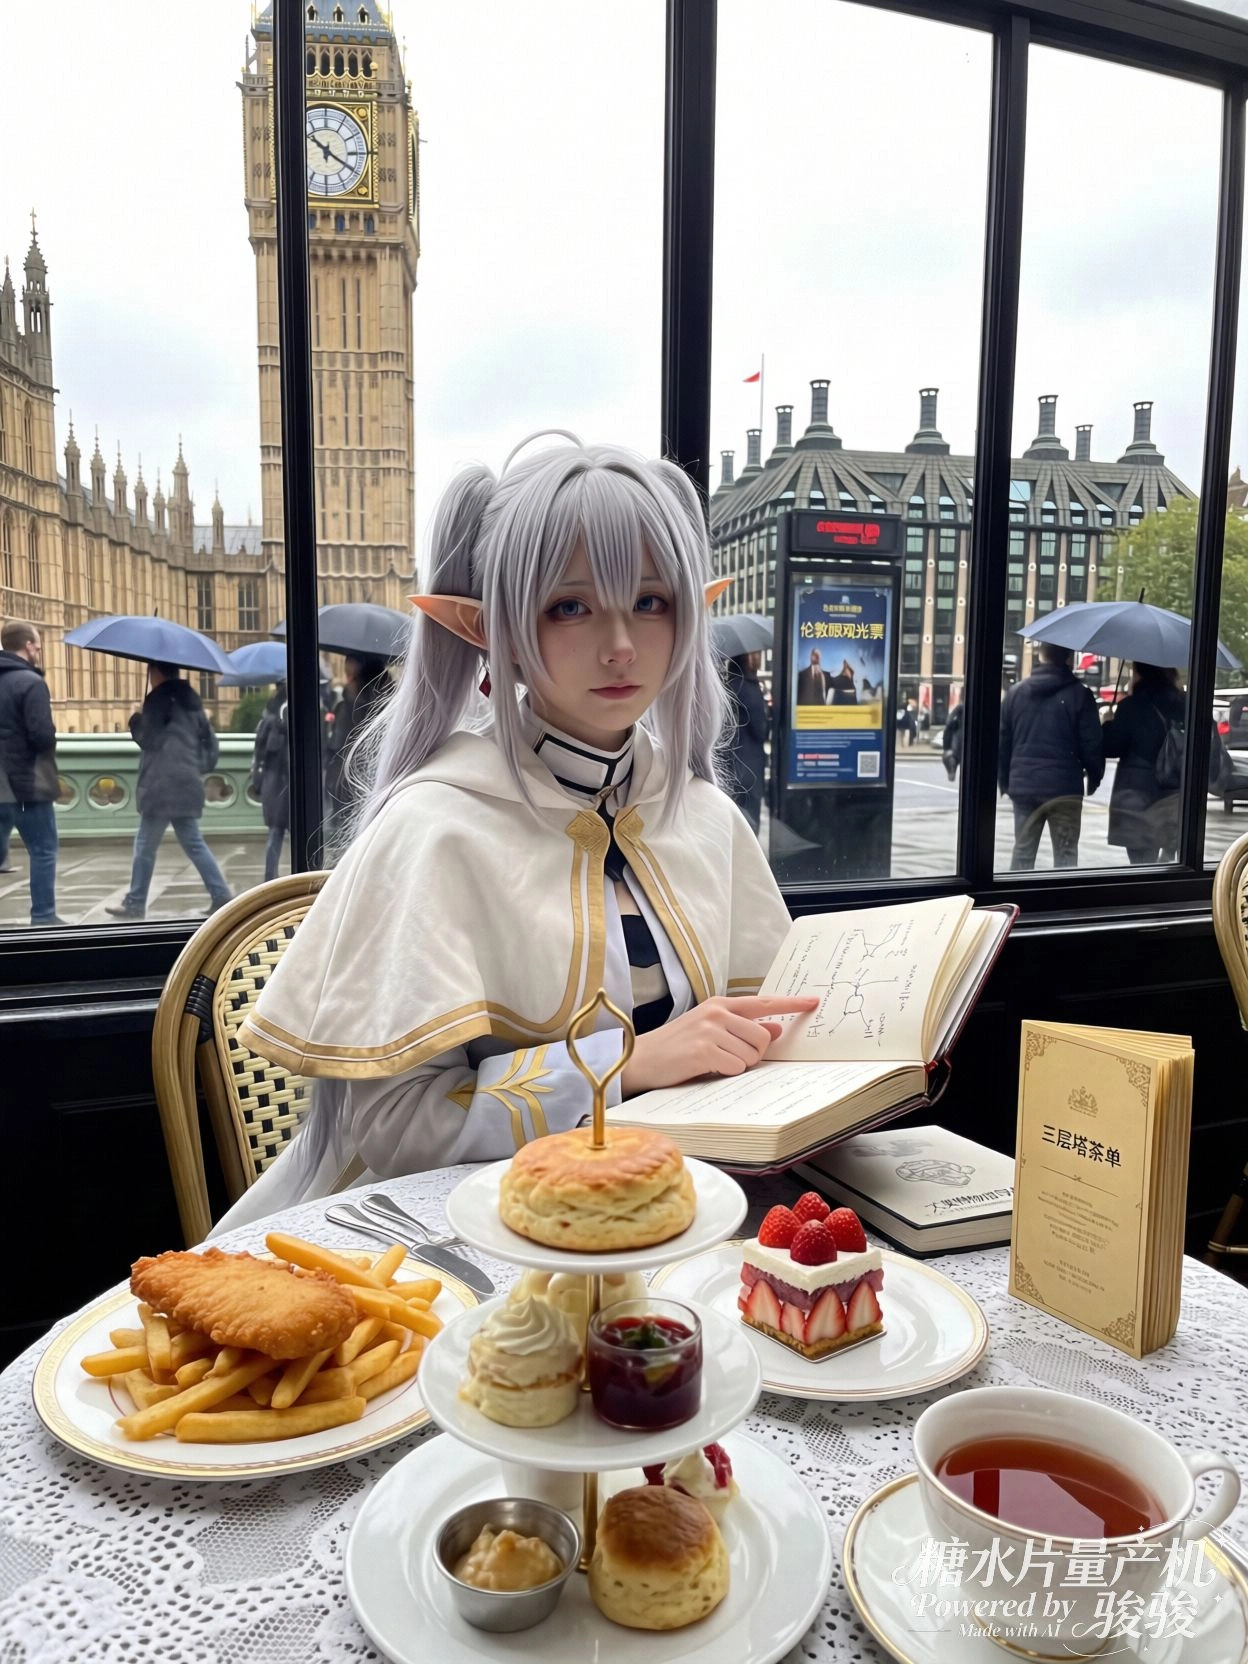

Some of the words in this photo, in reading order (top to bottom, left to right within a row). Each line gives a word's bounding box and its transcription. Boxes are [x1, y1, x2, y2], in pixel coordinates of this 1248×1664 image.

[1041, 1124, 1121, 1168] 三层塔茶单
